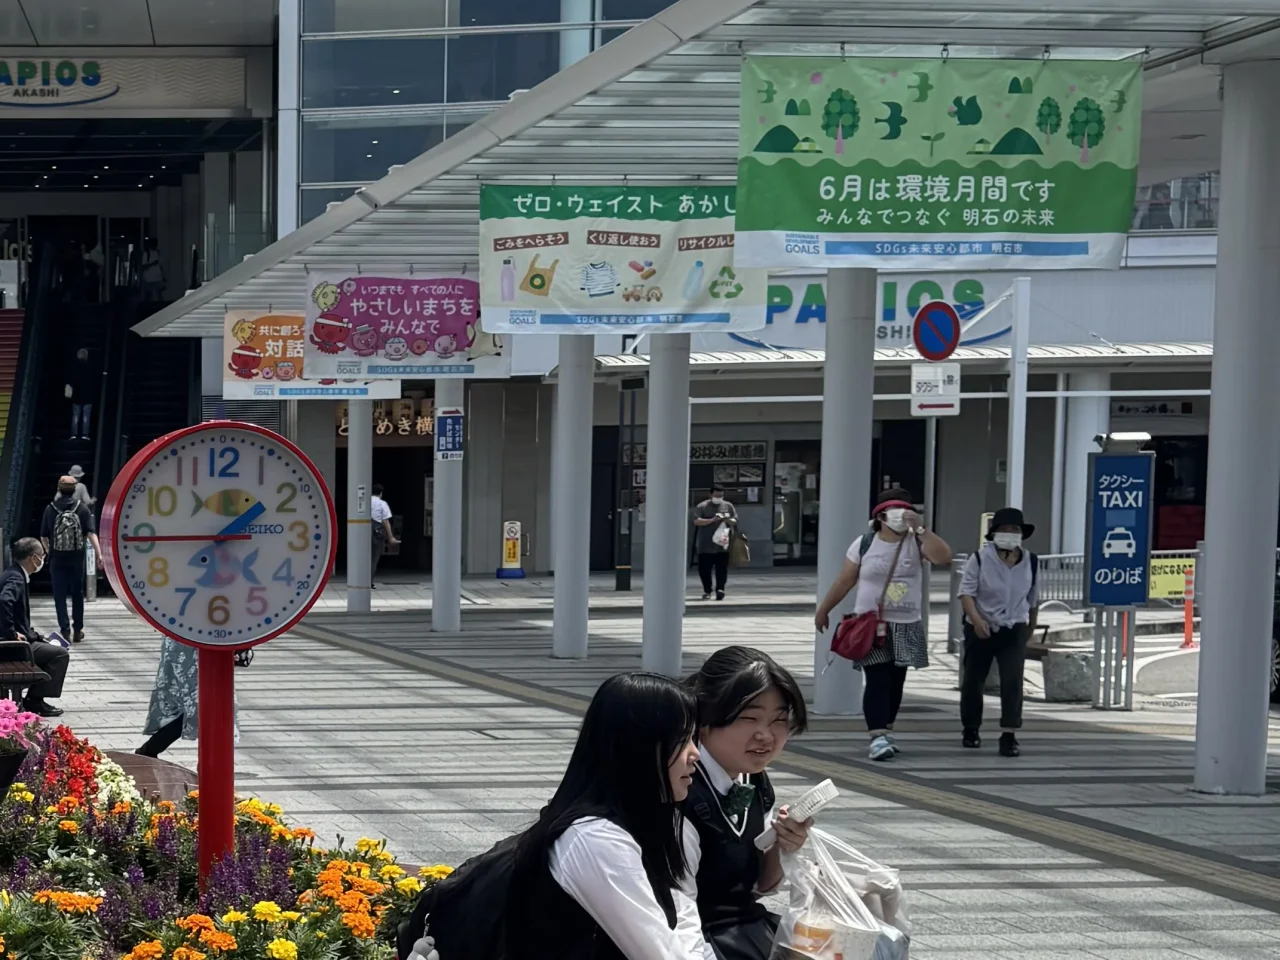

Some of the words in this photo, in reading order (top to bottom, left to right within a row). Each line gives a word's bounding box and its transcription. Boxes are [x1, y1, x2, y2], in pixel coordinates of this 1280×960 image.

[13, 88, 60, 97] AKASHI
[819, 174, 1055, 203] 6月は環境月間です
[513, 194, 663, 214] ゼロ・ウェイスト
[816, 208, 951, 226] みんなでつなぐ
[963, 208, 1055, 227] 明石の未来
[496, 235, 565, 251] ごみをへらそう
[785, 244, 820, 255] GOALS
[361, 285, 405, 296] いつまでも
[411, 284, 464, 295] すべての人に
[350, 298, 474, 317] やさしいまちを
[767, 279, 985, 324] PAIOS
[380, 319, 440, 334] みんなで
[177, 456, 198, 486] 11
[209, 447, 240, 478] 12
[258, 455, 264, 485] 1
[133, 484, 146, 493] 50
[300, 484, 310, 493] 10
[1099, 474, 1144, 489] タクシー
[147, 486, 177, 516] 10
[275, 482, 297, 513] 2
[1099, 491, 1143, 508] TAXI
[133, 523, 156, 553] 9
[239, 524, 284, 534] SEIKO
[287, 521, 310, 552] 3
[147, 556, 169, 587] 8
[272, 557, 295, 586] 4
[1094, 567, 1144, 585] のりば
[132, 581, 145, 590] 40
[297, 581, 309, 590] 20
[174, 587, 196, 616] 7
[207, 595, 230, 626] 6
[246, 587, 268, 616] 5
[213, 630, 226, 639] 30
